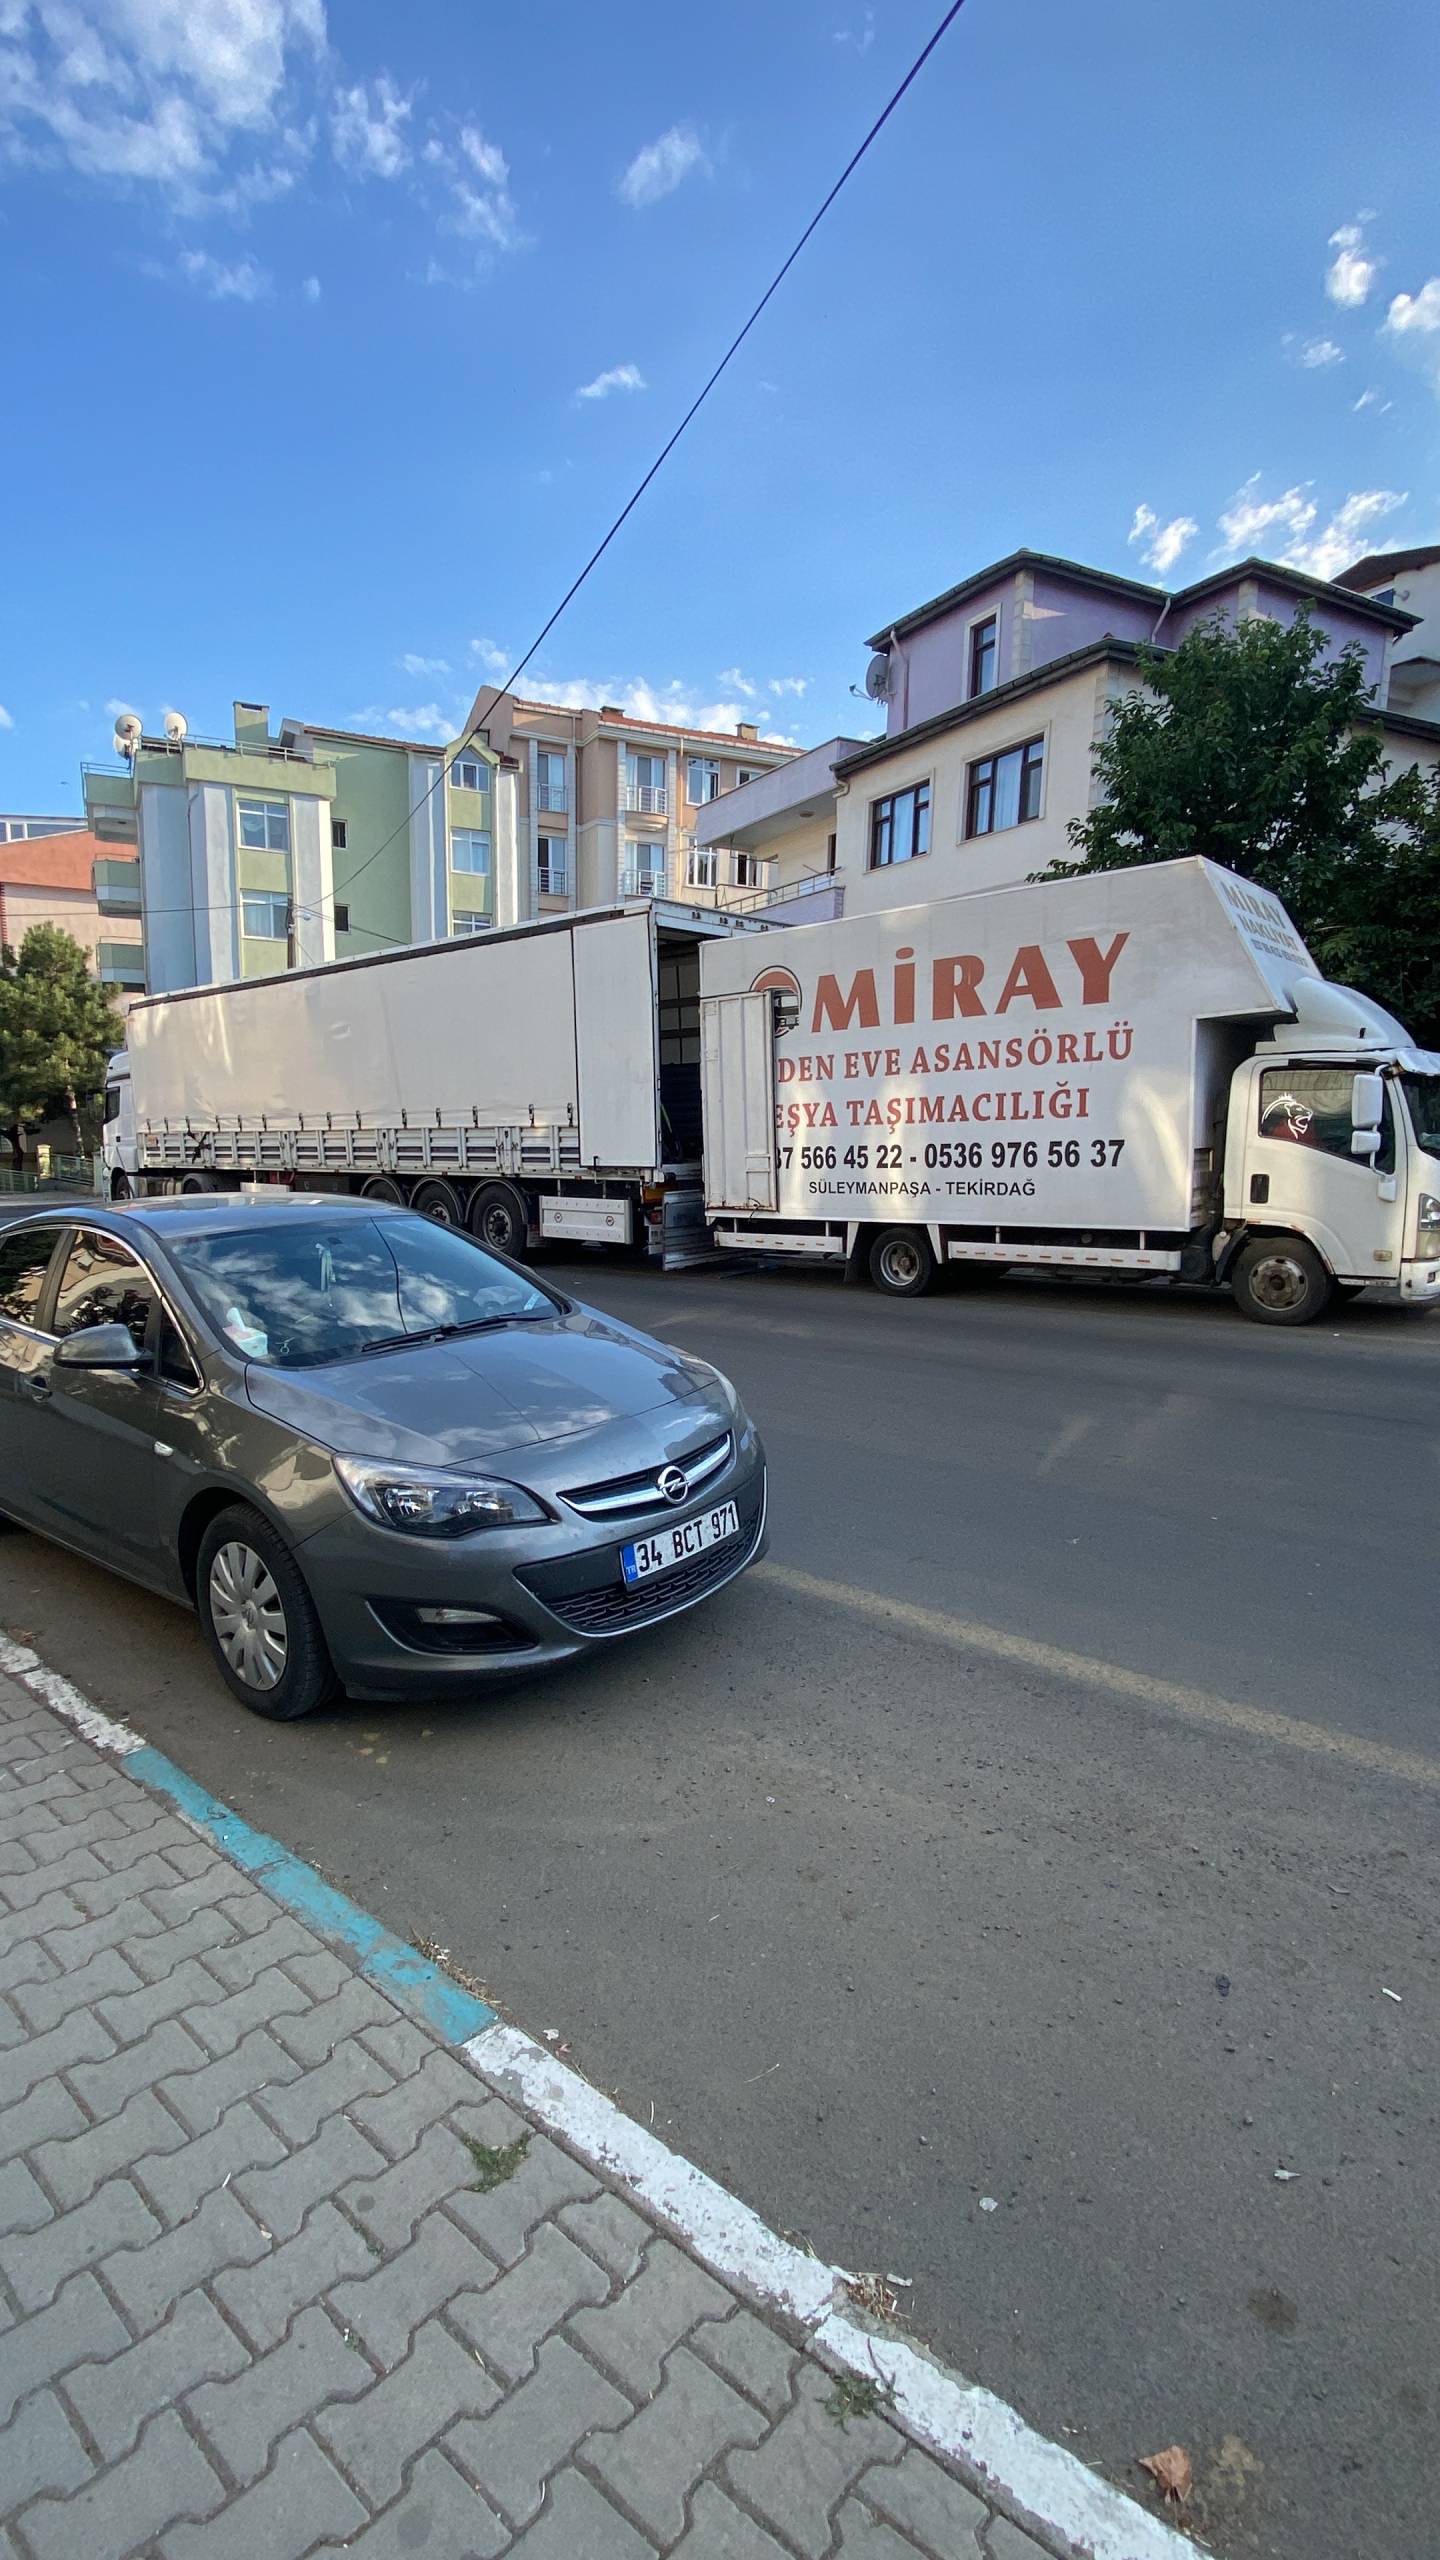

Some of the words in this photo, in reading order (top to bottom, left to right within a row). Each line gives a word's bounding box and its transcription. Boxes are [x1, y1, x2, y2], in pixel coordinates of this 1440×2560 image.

[1220, 881, 1286, 929] MİRAY
[811, 932, 1130, 1033] MİRAY
[778, 1054, 835, 1083] DEN
[844, 1048, 901, 1079] EVE
[910, 1020, 1134, 1074] ASANSÖRLÜ
[846, 1081, 1090, 1135] TAŞIMACILIĞI
[801, 1145, 837, 1170] 566
[843, 1145, 869, 1169] 45
[876, 1144, 903, 1169] 22
[924, 1142, 983, 1169] 0536
[991, 1141, 1038, 1168] 976
[1047, 1140, 1081, 1168] 56
[1090, 1139, 1125, 1167] 37
[808, 1178, 931, 1197] SÜLEYMANPAŞA
[945, 1178, 1036, 1196] TEKİRDAĞ
[637, 1540, 663, 1573] 34
[672, 1520, 703, 1559] BCT
[711, 1503, 736, 1539] 971
